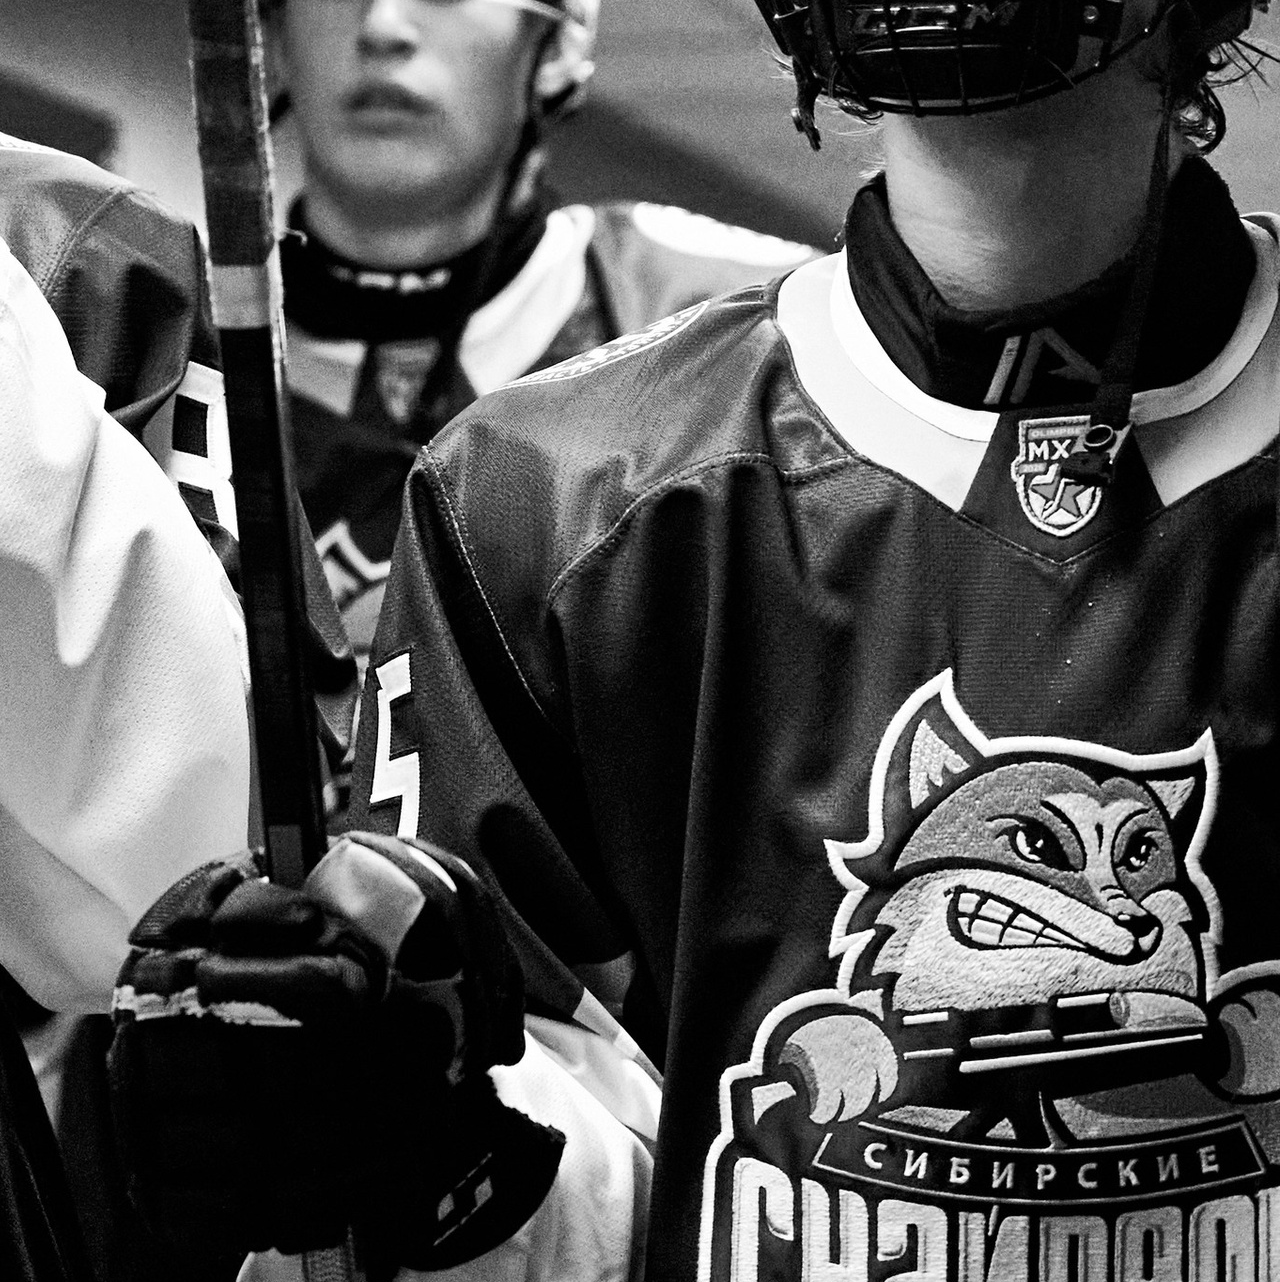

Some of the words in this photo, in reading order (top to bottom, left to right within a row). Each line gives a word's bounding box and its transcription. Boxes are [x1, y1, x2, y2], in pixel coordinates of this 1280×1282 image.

[1031, 426, 1083, 438] OLIMPBE
[1028, 439, 1071, 462] МХ
[863, 1143, 1221, 1191] СИБИРСКИЕ
